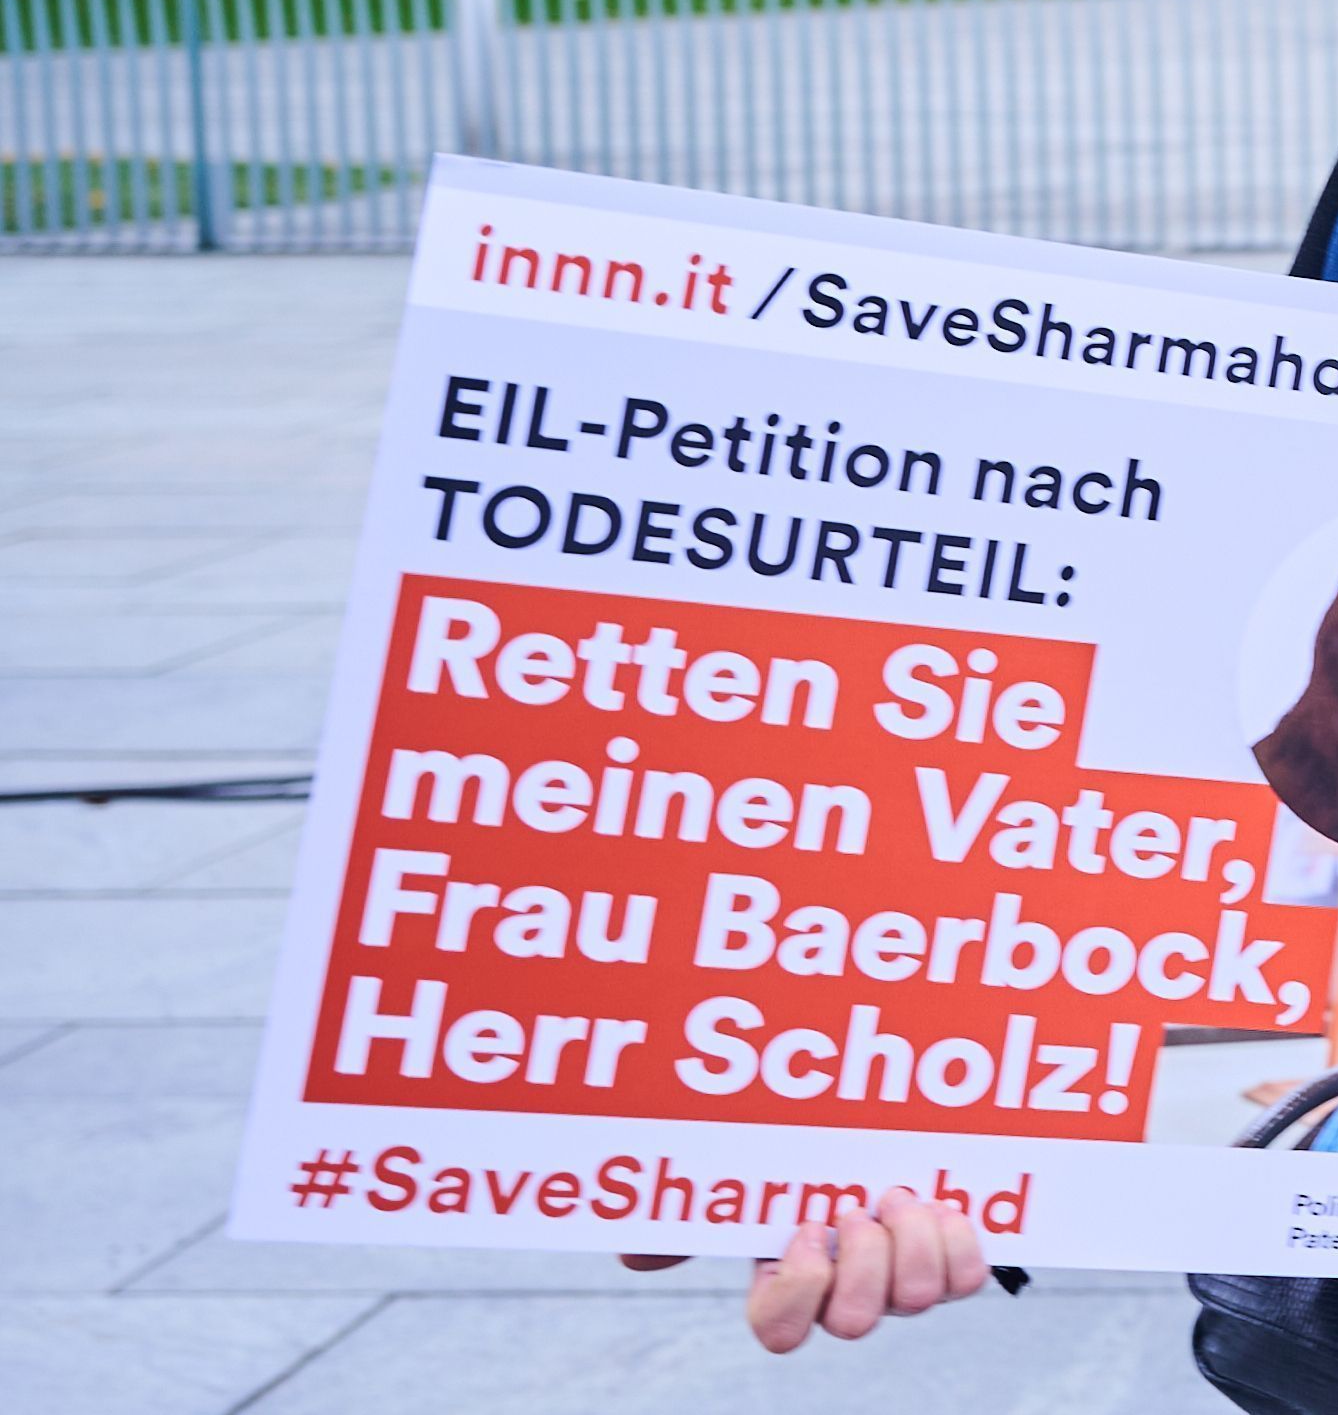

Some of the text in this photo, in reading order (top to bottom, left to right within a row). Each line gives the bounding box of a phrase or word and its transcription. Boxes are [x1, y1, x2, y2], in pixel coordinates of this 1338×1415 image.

[438, 375, 1161, 521] EIL-Petition nach
[424, 476, 1076, 607] TODESURTEIL:
[407, 596, 1065, 750] Retten Sie
[381, 736, 1256, 904] meinen Vater,
[358, 848, 1311, 1026] Frau Baerbock,
[334, 976, 1139, 1116] Herr Scholz!
[291, 1146, 1032, 1236] #SaveSharmhd
